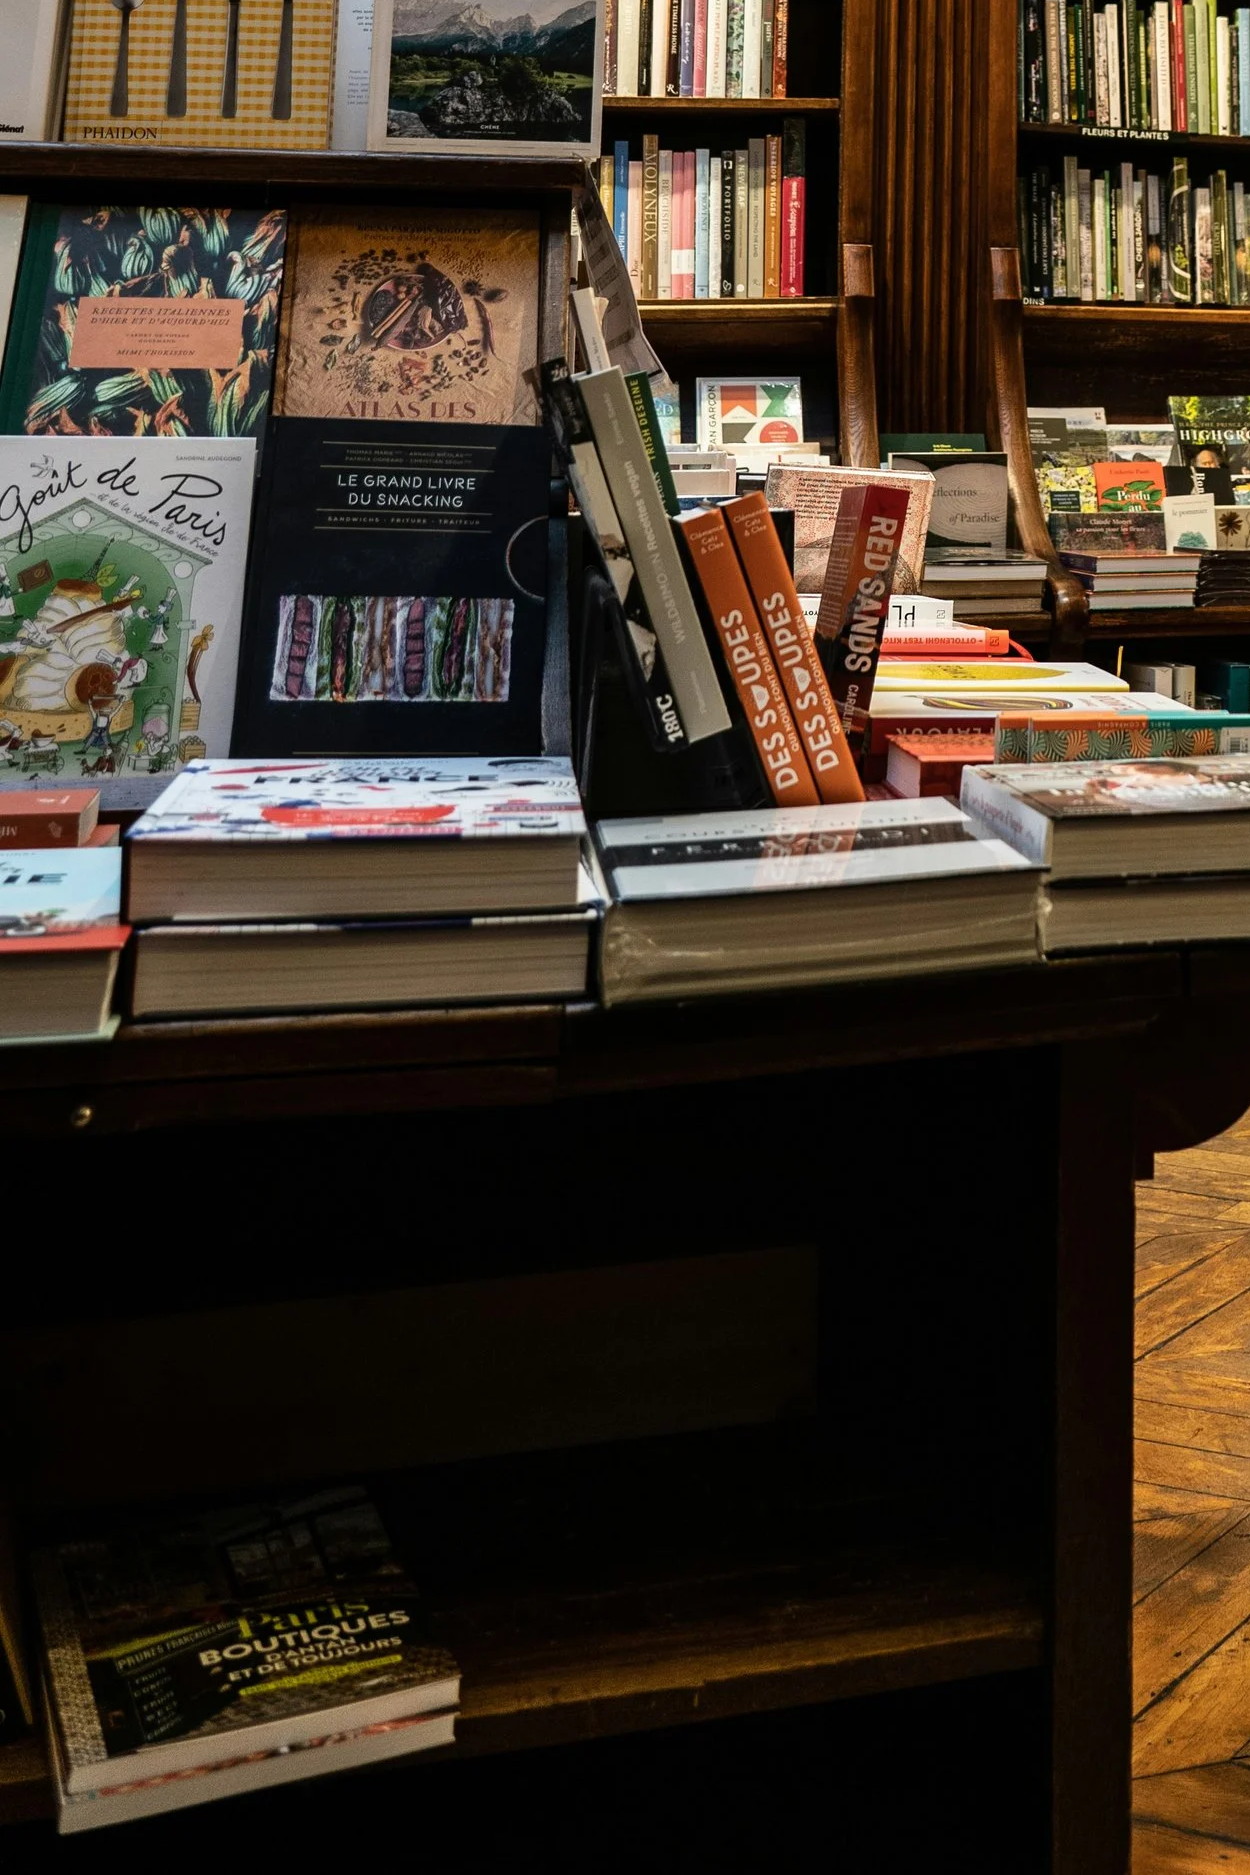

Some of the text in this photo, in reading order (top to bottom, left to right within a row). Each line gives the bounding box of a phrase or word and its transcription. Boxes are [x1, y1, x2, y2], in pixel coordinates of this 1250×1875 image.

[83, 126, 158, 140] PHAIDON
[1082, 127, 1169, 140] FLEURS ET PLANTES
[643, 153, 658, 243] MOLYNEUX
[90, 316, 231, 326] D'HIER ET D'AUJOURD'HUI
[92, 306, 232, 318] RECETTES ITALIENNES
[117, 348, 196, 357] MIMI THORISSON
[338, 400, 477, 419] ATLAS DES
[629, 379, 648, 426] DESEINE
[707, 385, 717, 428] GARÇON
[338, 474, 476, 490] LE GRAND LIVRE
[97, 457, 139, 496] de
[149, 474, 227, 546] Paris
[349, 493, 463, 508] DU SNACKING
[933, 486, 978, 498] eflections
[1117, 491, 1150, 501] Perdu
[949, 512, 1001, 524] of Paradise
[845, 515, 898, 673] RED SANDS
[924, 637, 976, 645] OTTOLENGHI
[803, 713, 840, 772] DES
[763, 730, 799, 791] DES
[239, 1598, 370, 1639] Paris
[199, 1610, 410, 1667] BOUTIQUES
[229, 1636, 402, 1681] ET DE TOUJOURS
[265, 1636, 357, 1663] D'ANTAN
